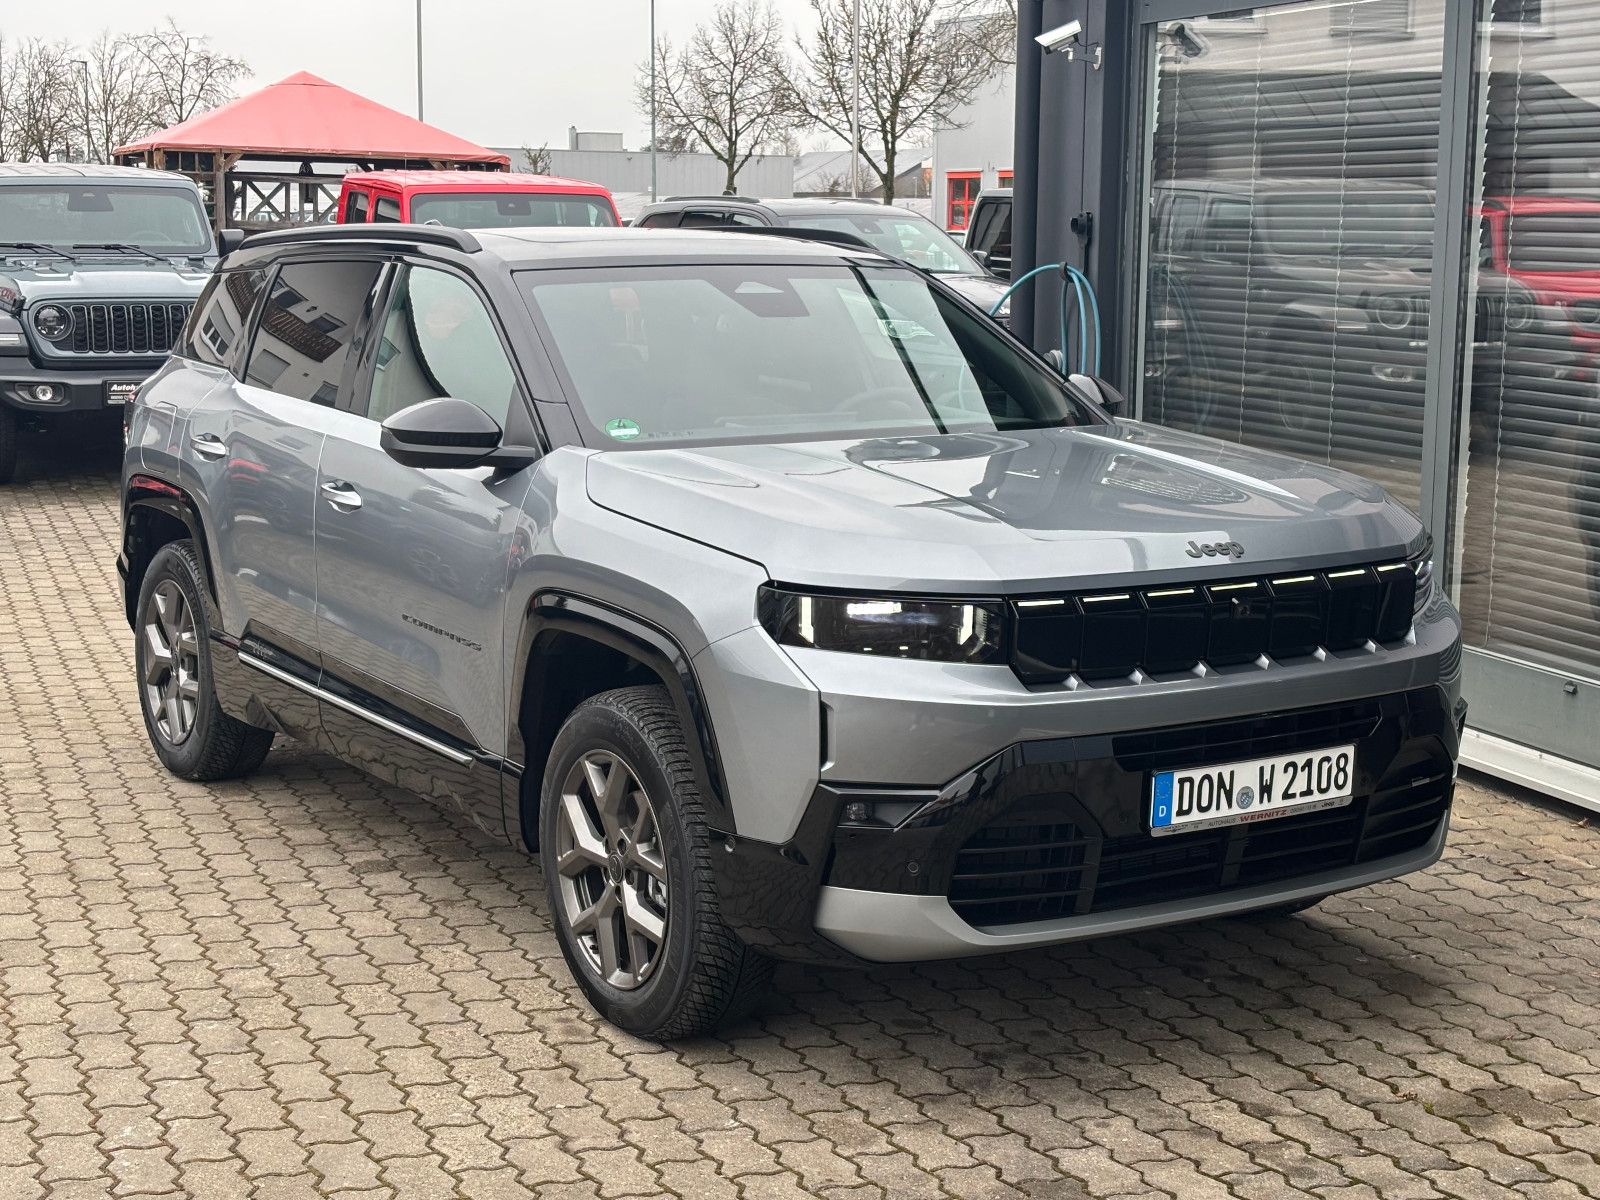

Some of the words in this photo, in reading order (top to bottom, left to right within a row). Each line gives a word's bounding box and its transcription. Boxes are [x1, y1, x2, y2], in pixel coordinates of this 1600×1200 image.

[111, 383, 138, 391] Autoh
[1185, 541, 1244, 558] Jeep
[402, 613, 481, 651] COMPASS
[1176, 770, 1234, 817] DON
[1259, 764, 1275, 804] W
[1282, 753, 1349, 800] 2108
[1158, 805, 1166, 817] D
[1240, 810, 1287, 821] WERNITZ
